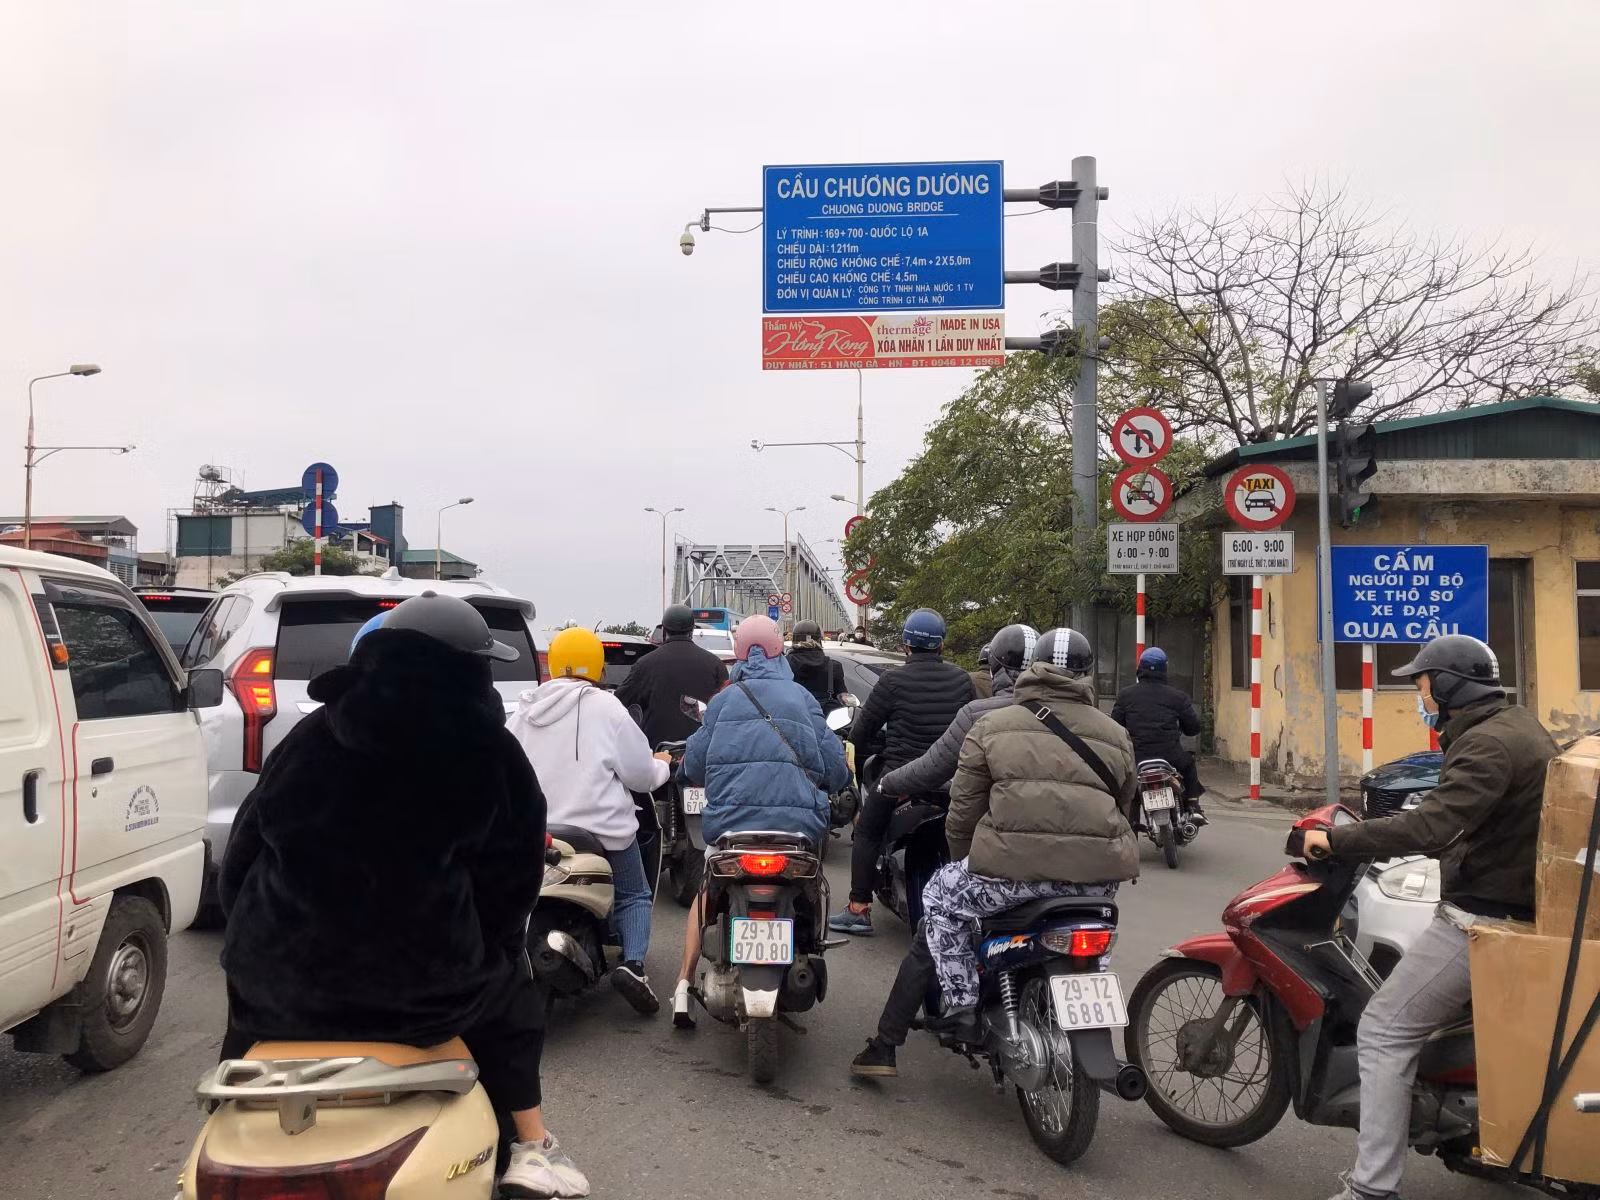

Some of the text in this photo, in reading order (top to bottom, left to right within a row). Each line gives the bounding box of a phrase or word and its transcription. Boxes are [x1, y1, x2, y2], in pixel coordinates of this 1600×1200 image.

[777, 172, 989, 198] CẦU CHƯƠNG DƯƠNG
[821, 201, 944, 215] CHUONG DUONG BRIDGE
[776, 227, 788, 240] LÝ
[901, 225, 913, 238] LỘ
[917, 226, 929, 237] 1A
[809, 255, 838, 270] RỘNG
[809, 273, 829, 283] CAO
[812, 285, 839, 298] QUẢN
[858, 284, 879, 293] CÔNG
[882, 284, 892, 293] TY
[895, 284, 913, 293] TNHH
[964, 283, 974, 292] TV
[858, 296, 879, 305] CÔNG
[906, 296, 916, 304] GT
[877, 325, 932, 336] thermage
[940, 318, 1001, 331] MADE IN USA
[928, 340, 932, 352] 1
[956, 339, 975, 351] DUY
[977, 333, 1002, 351] NHẤT
[765, 361, 785, 369] DUY
[888, 360, 903, 368] HN
[960, 358, 972, 366] 12
[1246, 479, 1275, 490] TAXI
[1112, 531, 1124, 541] XE
[1127, 530, 1145, 544] HỢP
[1117, 548, 1137, 558] 6:00
[1148, 548, 1169, 558] 9:00
[1232, 540, 1252, 552] 6:00
[1264, 540, 1284, 552] 9:00
[1374, 547, 1434, 571] CẤM
[1349, 571, 1464, 588] NGƯỜI ĐI BỘ
[1355, 587, 1454, 601] XE THÔ SƠ
[1371, 605, 1440, 618] XE ĐẠP
[1343, 622, 1398, 639] QUA
[740, 921, 783, 940] 29-X1
[735, 942, 788, 961] 970.80
[1061, 977, 1113, 1001] 29-T2
[1066, 1001, 1117, 1025] 6881
